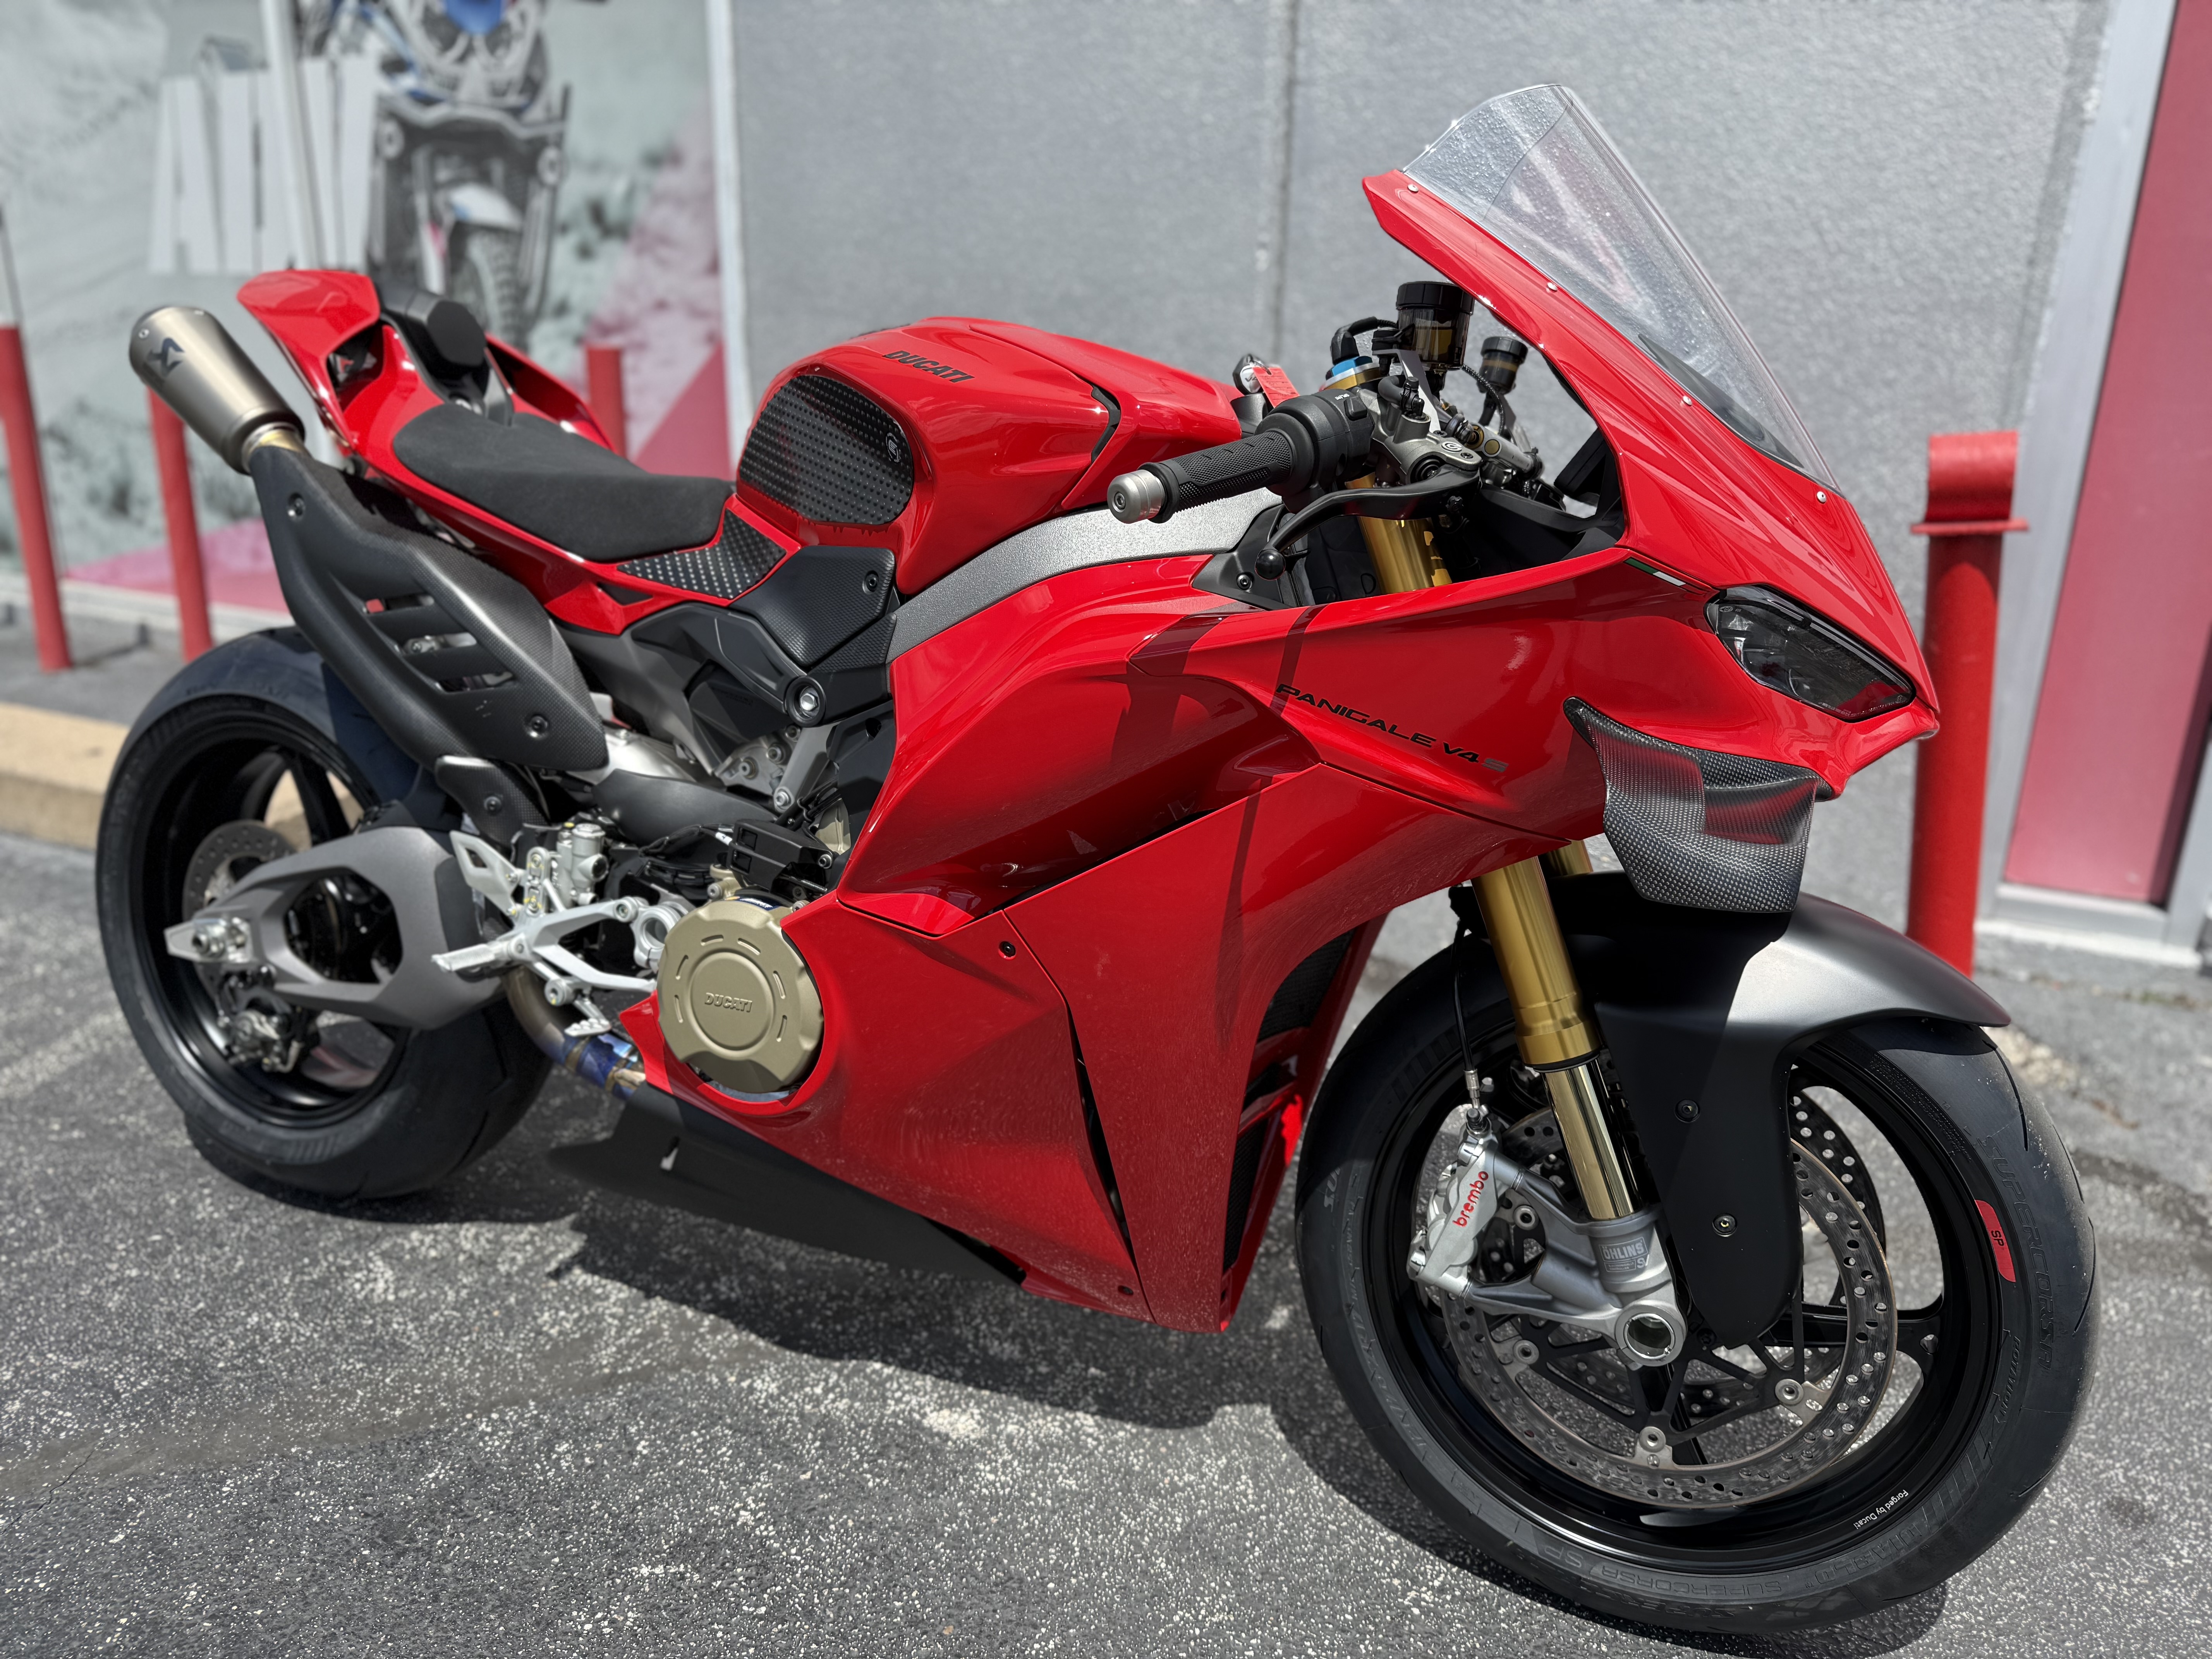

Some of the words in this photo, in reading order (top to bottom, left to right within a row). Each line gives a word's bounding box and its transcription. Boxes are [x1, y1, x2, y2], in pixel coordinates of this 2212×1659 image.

[882, 350, 975, 383] DUCATI
[1276, 683, 1437, 748] PANIGALE
[704, 992, 752, 1013] DUCATI
[1452, 1171, 1489, 1227] brembo
[1991, 1230, 2004, 1247] SP
[1602, 1242, 1644, 1260] ÖHLINS
[1977, 1135, 2054, 1370] SUPERCORSA
[1876, 1507, 1887, 1515] by
[1885, 1489, 1909, 1510] Forged
[1853, 1513, 1877, 1529] Ducati
[1541, 1544, 1583, 1568] SP
[1814, 1523, 1922, 1584] DIABLO
[1601, 1565, 1782, 1597] SUPERCORSA
